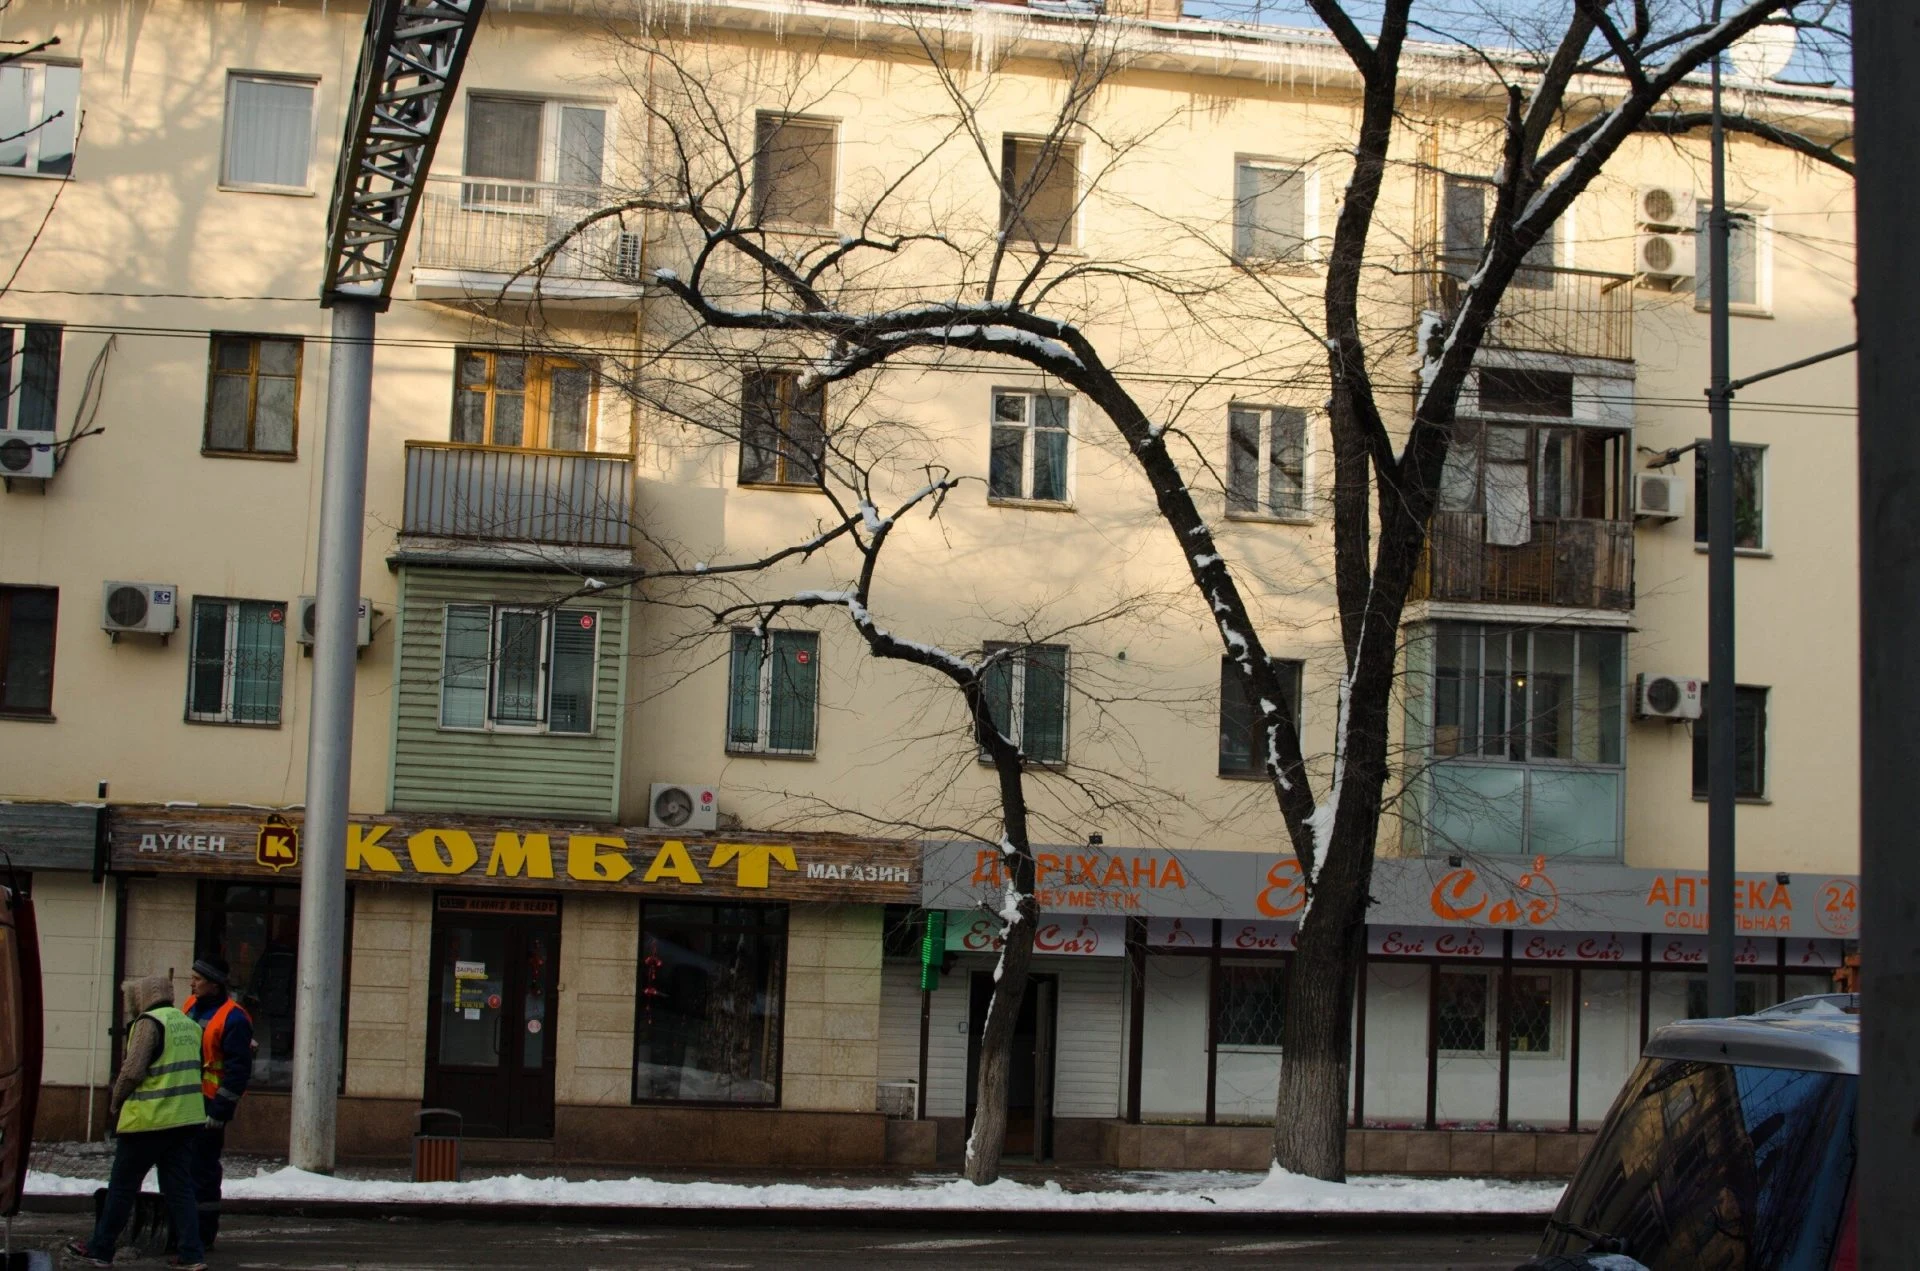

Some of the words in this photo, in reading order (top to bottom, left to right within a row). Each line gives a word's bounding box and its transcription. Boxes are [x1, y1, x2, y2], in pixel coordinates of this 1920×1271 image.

[139, 834, 225, 852] ДҮКЕН
[345, 824, 799, 888] КОМБАТ
[807, 863, 910, 882] МАГАЗИН
[971, 849, 1186, 889] ДРІХАНА
[1430, 866, 1558, 925] Car
[1825, 887, 1856, 912] 24
[1664, 911, 1791, 931] СОЦЛЬНАЯ
[1034, 923, 1098, 954] Car
[1235, 927, 1279, 948] Evi
[1382, 932, 1425, 954] Evi
[1435, 934, 1485, 955] Car
[1525, 936, 1567, 959] Evi
[1576, 938, 1625, 960] Car
[1663, 941, 1703, 962] Evi
